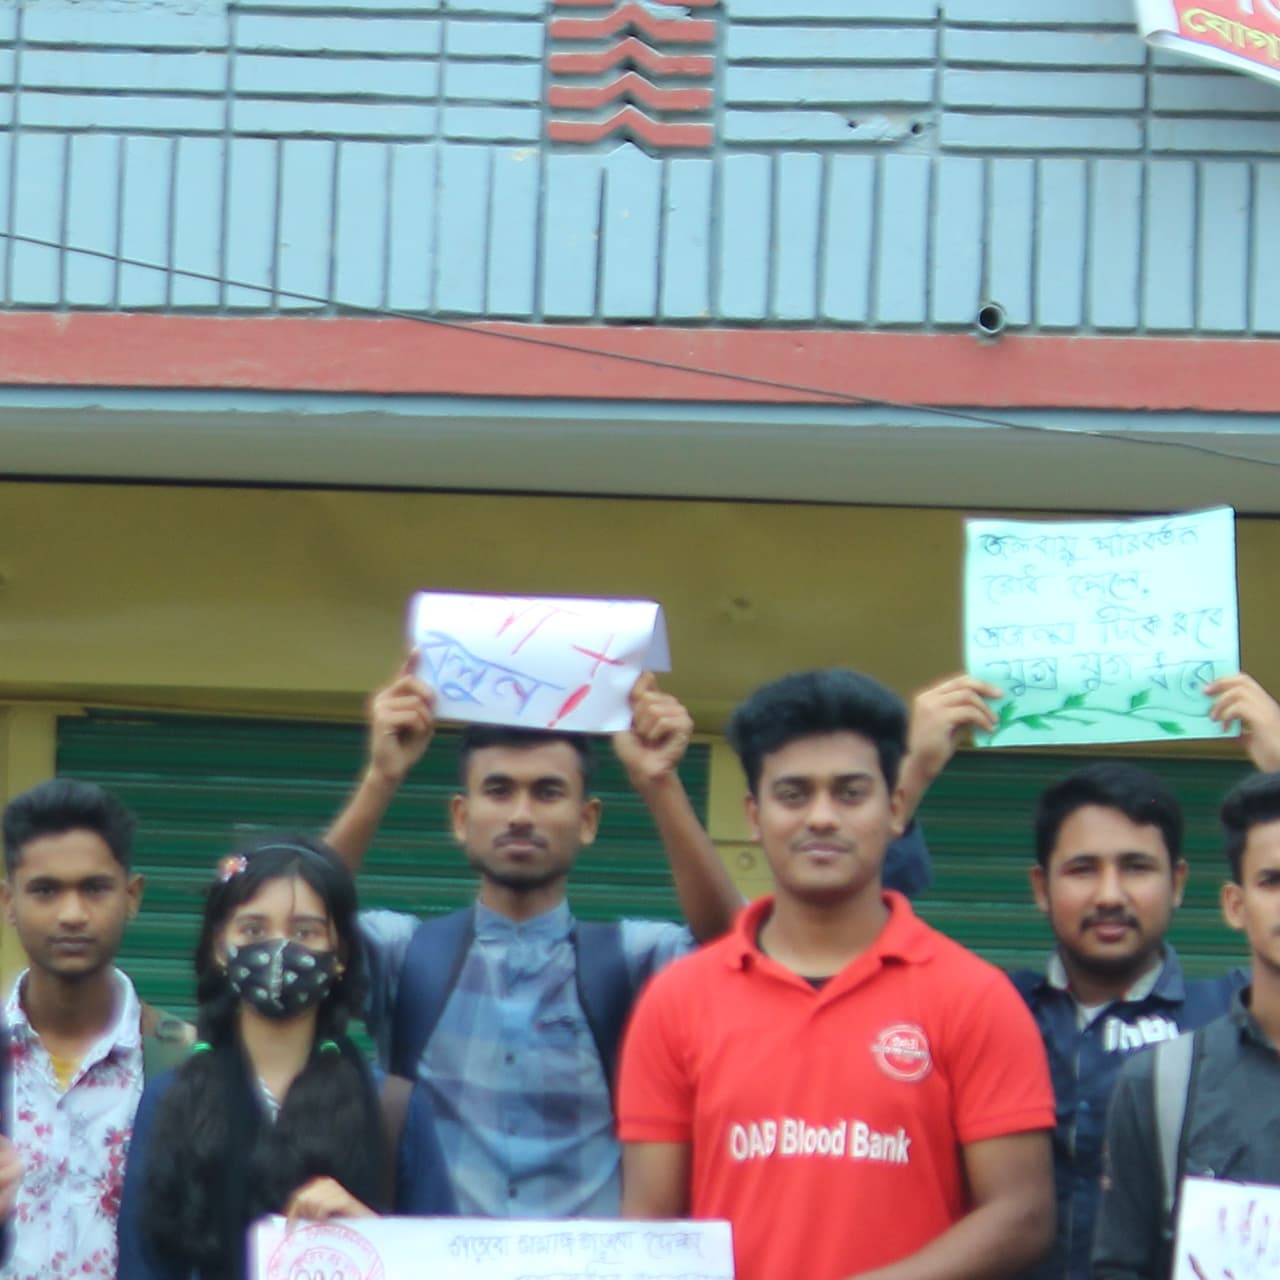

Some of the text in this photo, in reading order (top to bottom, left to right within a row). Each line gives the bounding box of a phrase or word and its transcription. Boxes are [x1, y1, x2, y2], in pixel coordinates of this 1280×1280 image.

[730, 1115, 912, 1164] OAB Blood Bank
